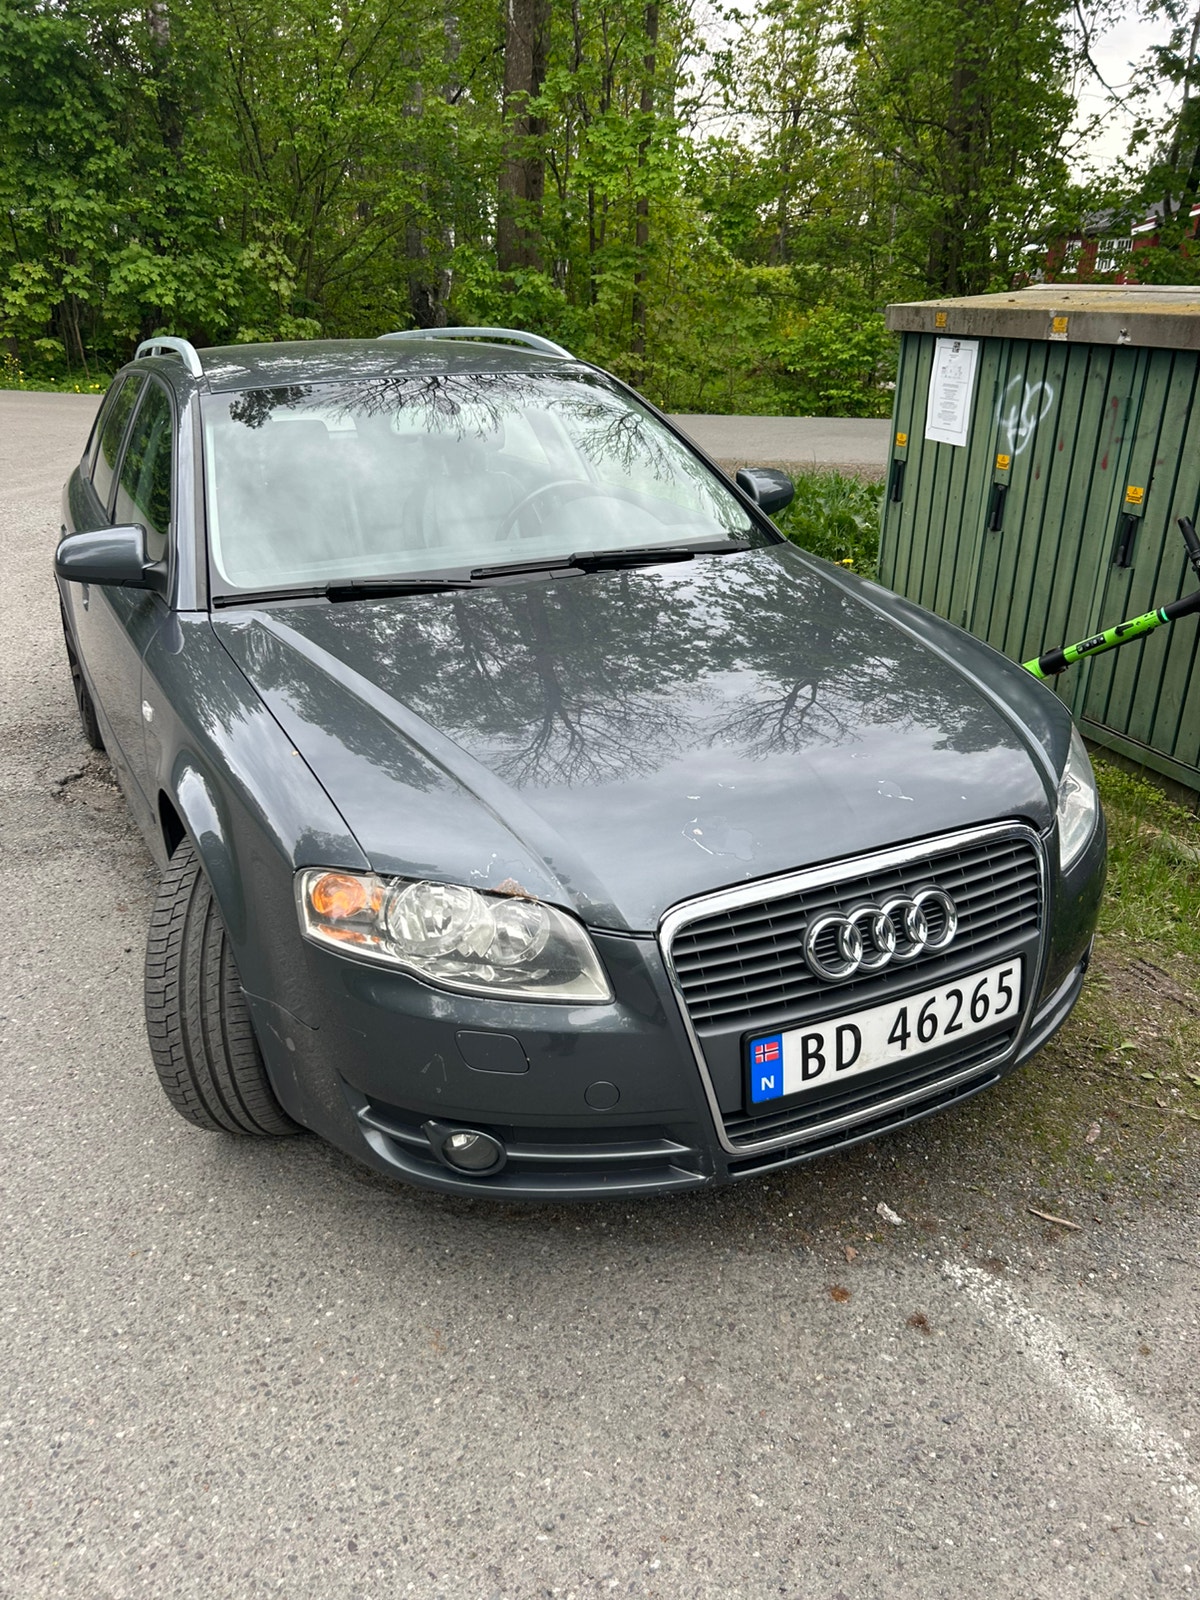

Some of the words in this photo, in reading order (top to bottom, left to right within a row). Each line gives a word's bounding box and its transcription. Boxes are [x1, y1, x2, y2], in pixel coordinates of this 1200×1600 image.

[801, 1023, 862, 1081] BD
[887, 968, 1013, 1050] 46265
[761, 1075, 775, 1091] N
